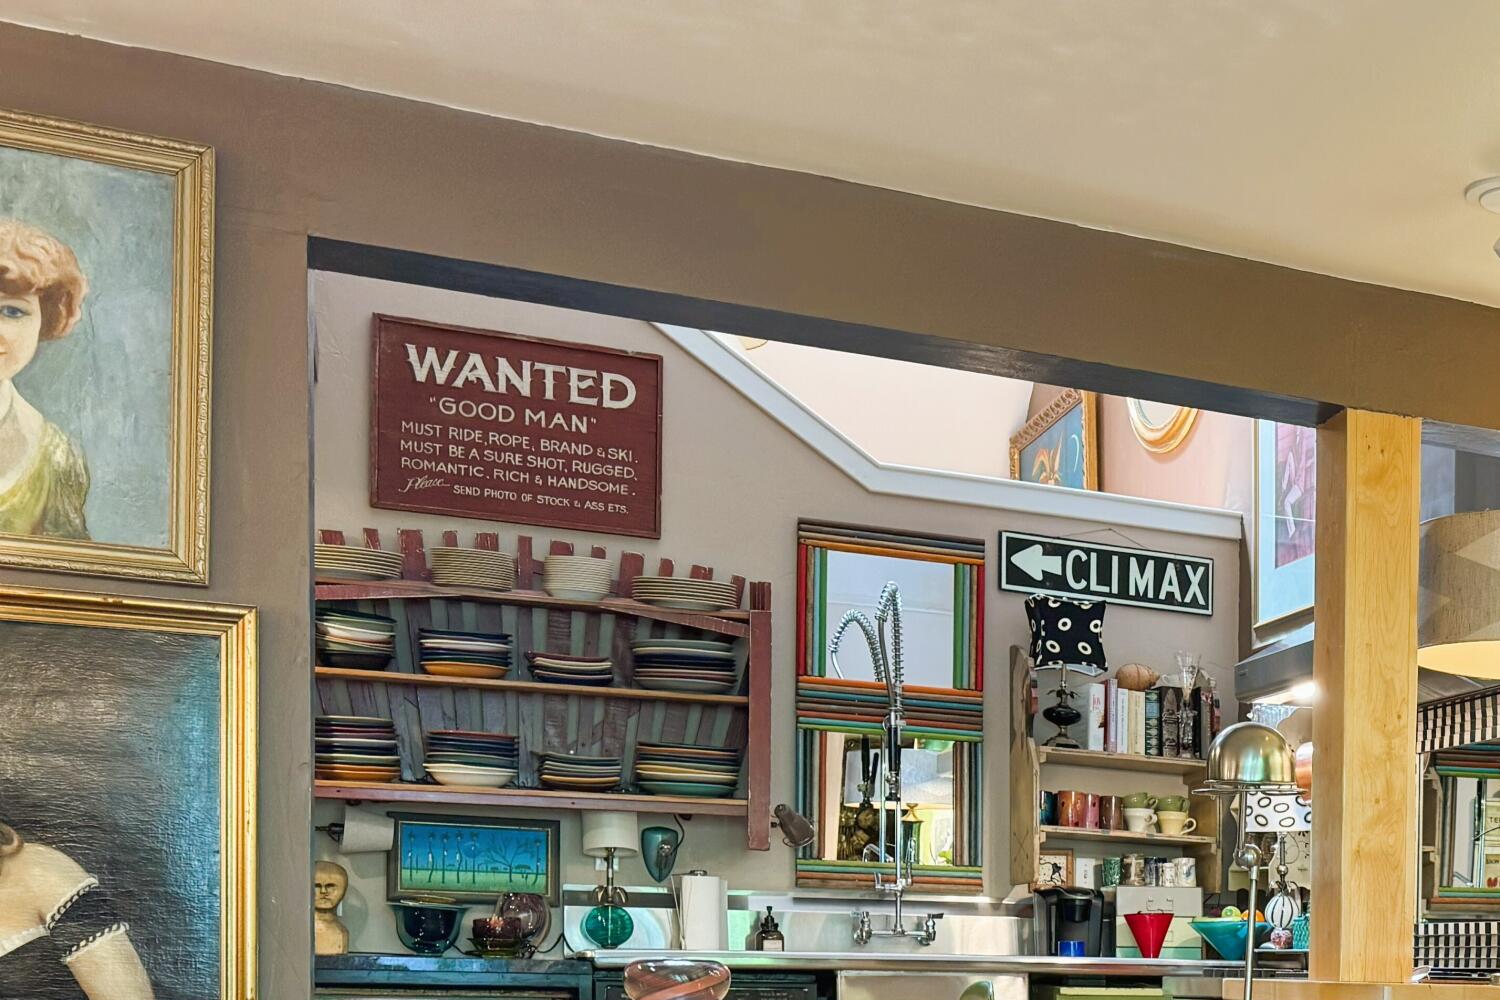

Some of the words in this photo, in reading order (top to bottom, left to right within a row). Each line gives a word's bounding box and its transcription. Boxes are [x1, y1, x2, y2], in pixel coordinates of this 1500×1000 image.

[405, 343, 637, 410] WANTED
[429, 396, 515, 423] "GOOD
[525, 408, 597, 434] MAN"
[400, 439, 443, 456] MUST
[448, 445, 466, 459] BE
[468, 448, 480, 461] A
[483, 450, 524, 466] SURE
[401, 420, 443, 438] MUST
[540, 439, 594, 456] BRAND
[596, 447, 606, 459] &
[607, 447, 639, 464] SKI.
[452, 484, 481, 496] SEND
[484, 488, 517, 501] PHOTO
[520, 492, 534, 503] OF
[536, 494, 571, 508] STOCK
[493, 468, 530, 484] RICH
[534, 475, 543, 487] &
[1065, 549, 1206, 606] CLIMAX
